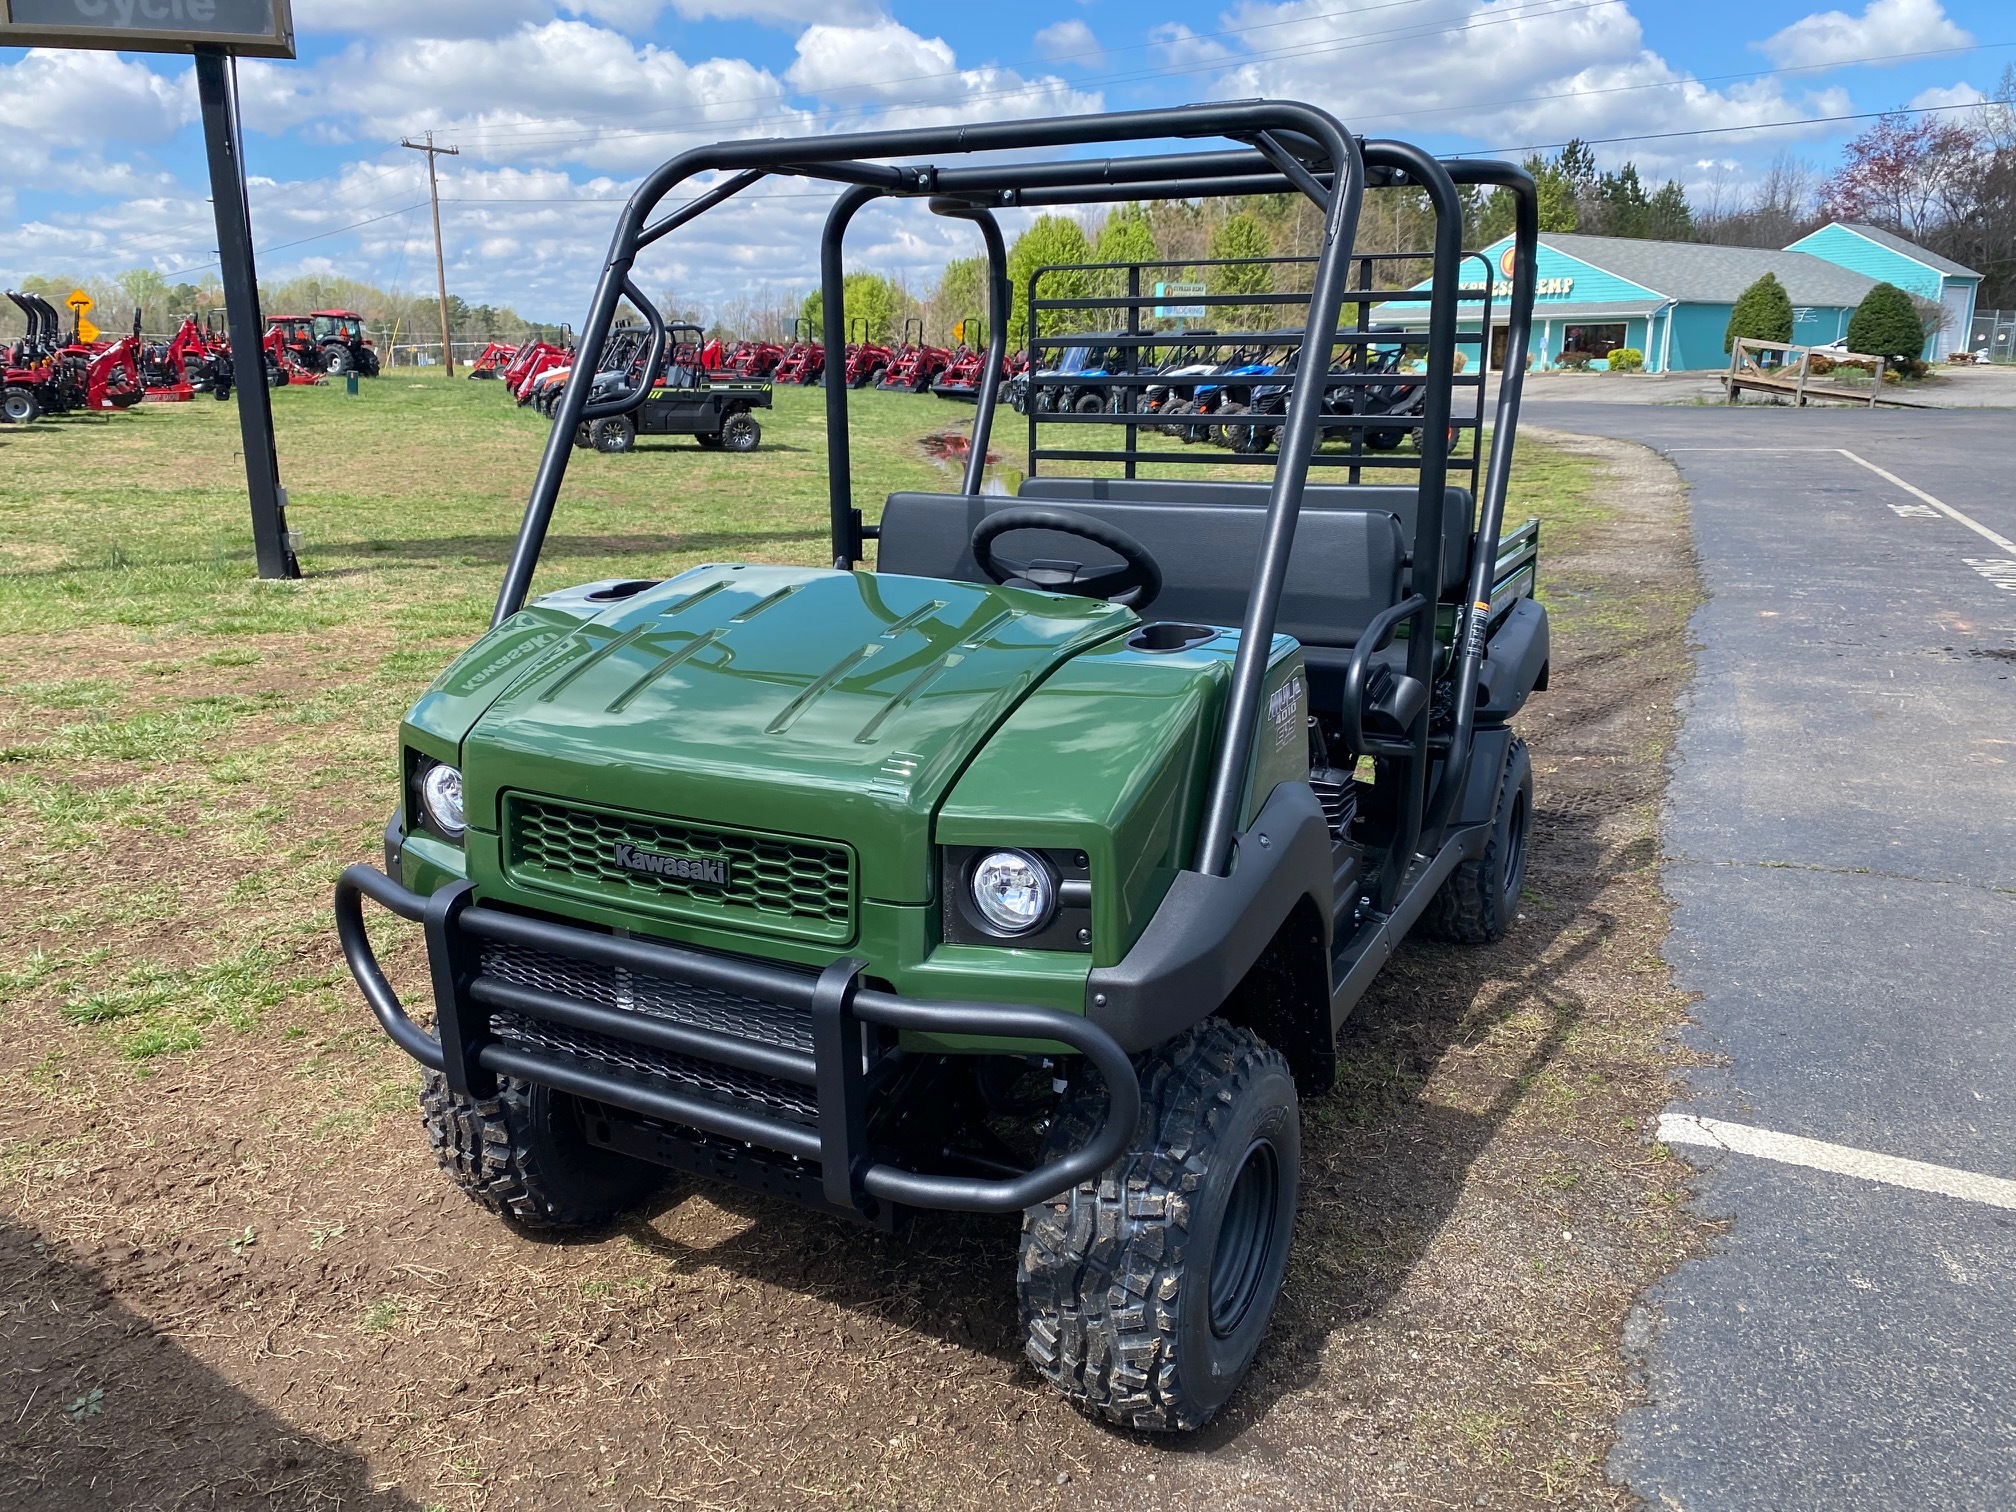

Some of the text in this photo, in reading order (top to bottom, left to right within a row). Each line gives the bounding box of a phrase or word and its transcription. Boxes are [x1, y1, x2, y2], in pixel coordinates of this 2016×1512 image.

[1535, 278, 1574, 295] EMP
[1275, 701, 1297, 725] 4010
[615, 844, 725, 884] Kawasaki
